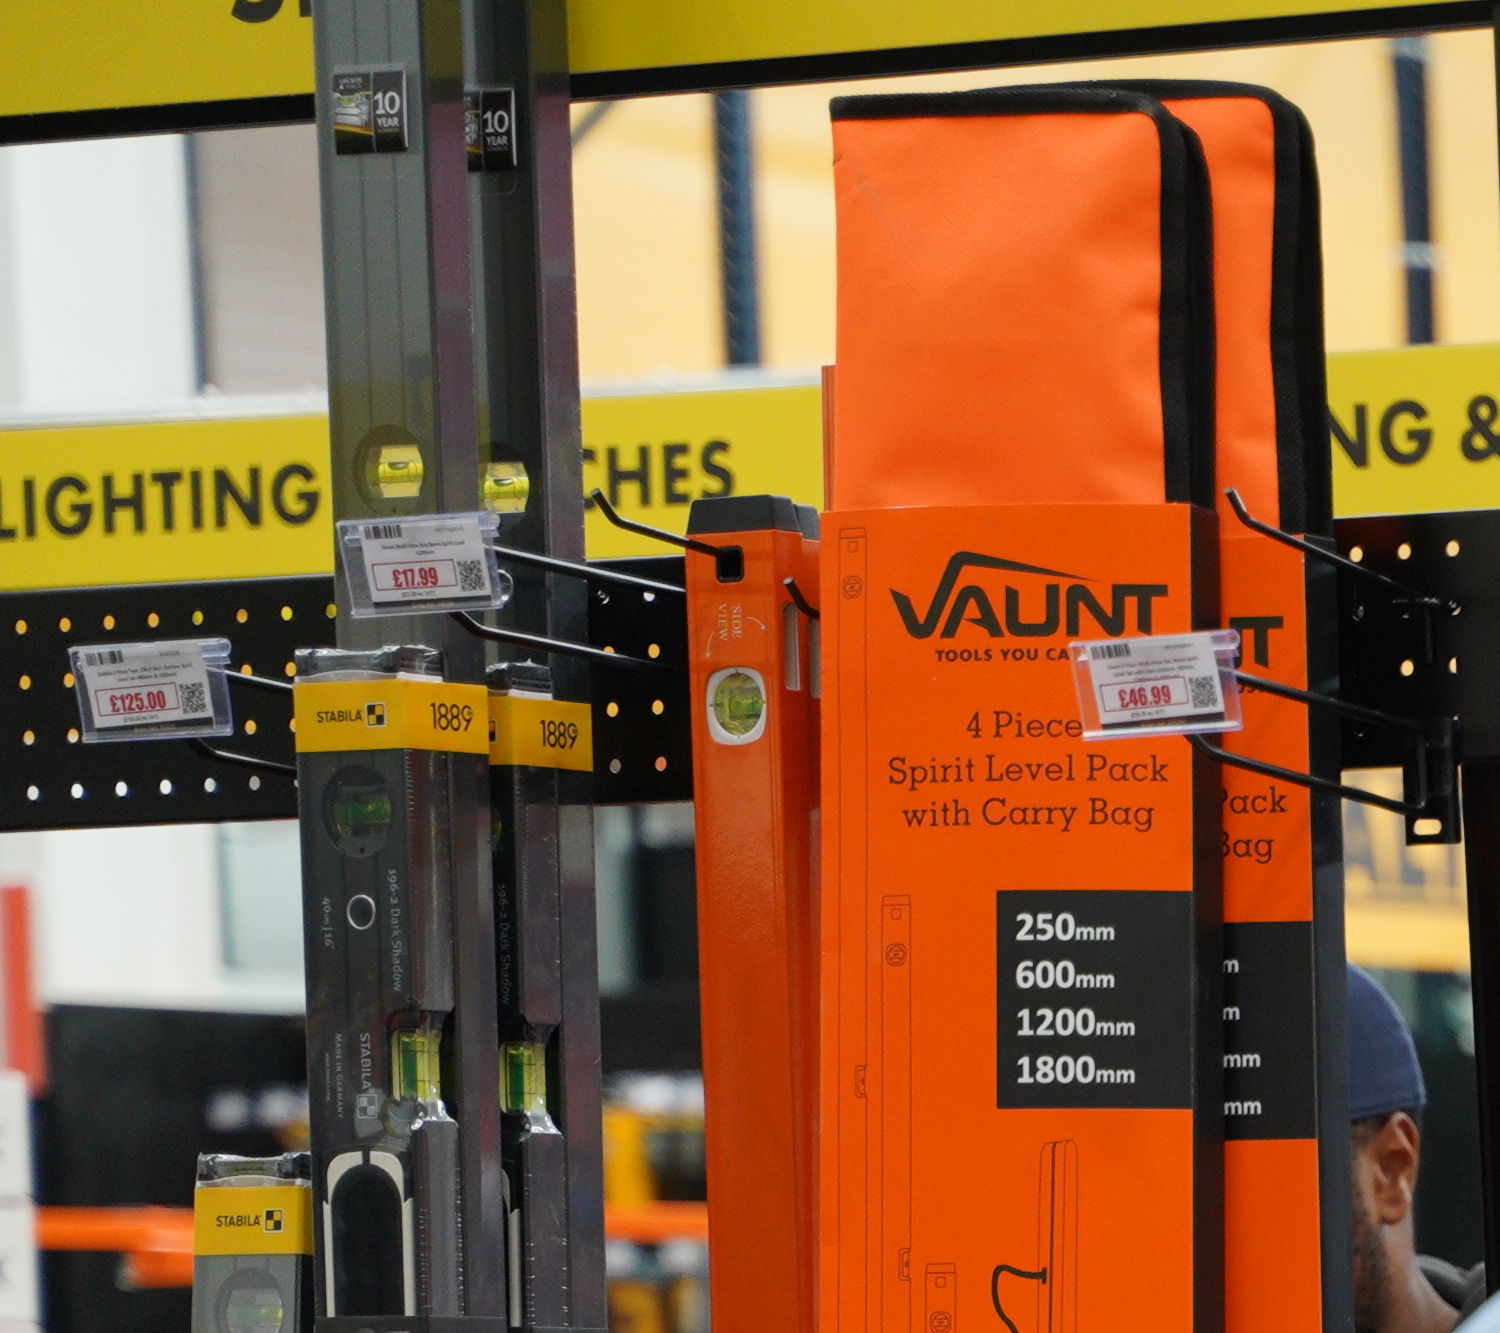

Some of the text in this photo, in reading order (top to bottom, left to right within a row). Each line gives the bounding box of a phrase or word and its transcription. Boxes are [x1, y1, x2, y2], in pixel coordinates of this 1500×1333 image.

[374, 91, 400, 115] 10
[376, 116, 400, 128] YEAR
[483, 110, 509, 133] 10
[485, 134, 509, 146] YEAR
[392, 566, 439, 588] £17.99
[889, 551, 1168, 640] VAUNT
[731, 605, 743, 640] SIDE
[935, 648, 1072, 663] TOOLS YOU CA
[110, 690, 167, 713] £125.00
[1118, 685, 1172, 708] £46.99
[316, 709, 362, 723] STABILA
[430, 702, 473, 731] 1889
[966, 709, 1083, 739] 4 Piece
[889, 754, 1168, 791] Spirit Level Pack
[902, 797, 1155, 833] with Carry Bag
[387, 868, 406, 992] 196-2 Dark Shadow
[1015, 912, 1116, 942] 250mm
[1015, 960, 1116, 990] 600mm
[1016, 1008, 1136, 1037] 1200mm
[360, 1031, 373, 1090] STABILA
[1016, 1055, 1136, 1085] 1800mm
[216, 1216, 261, 1229] STABILA
